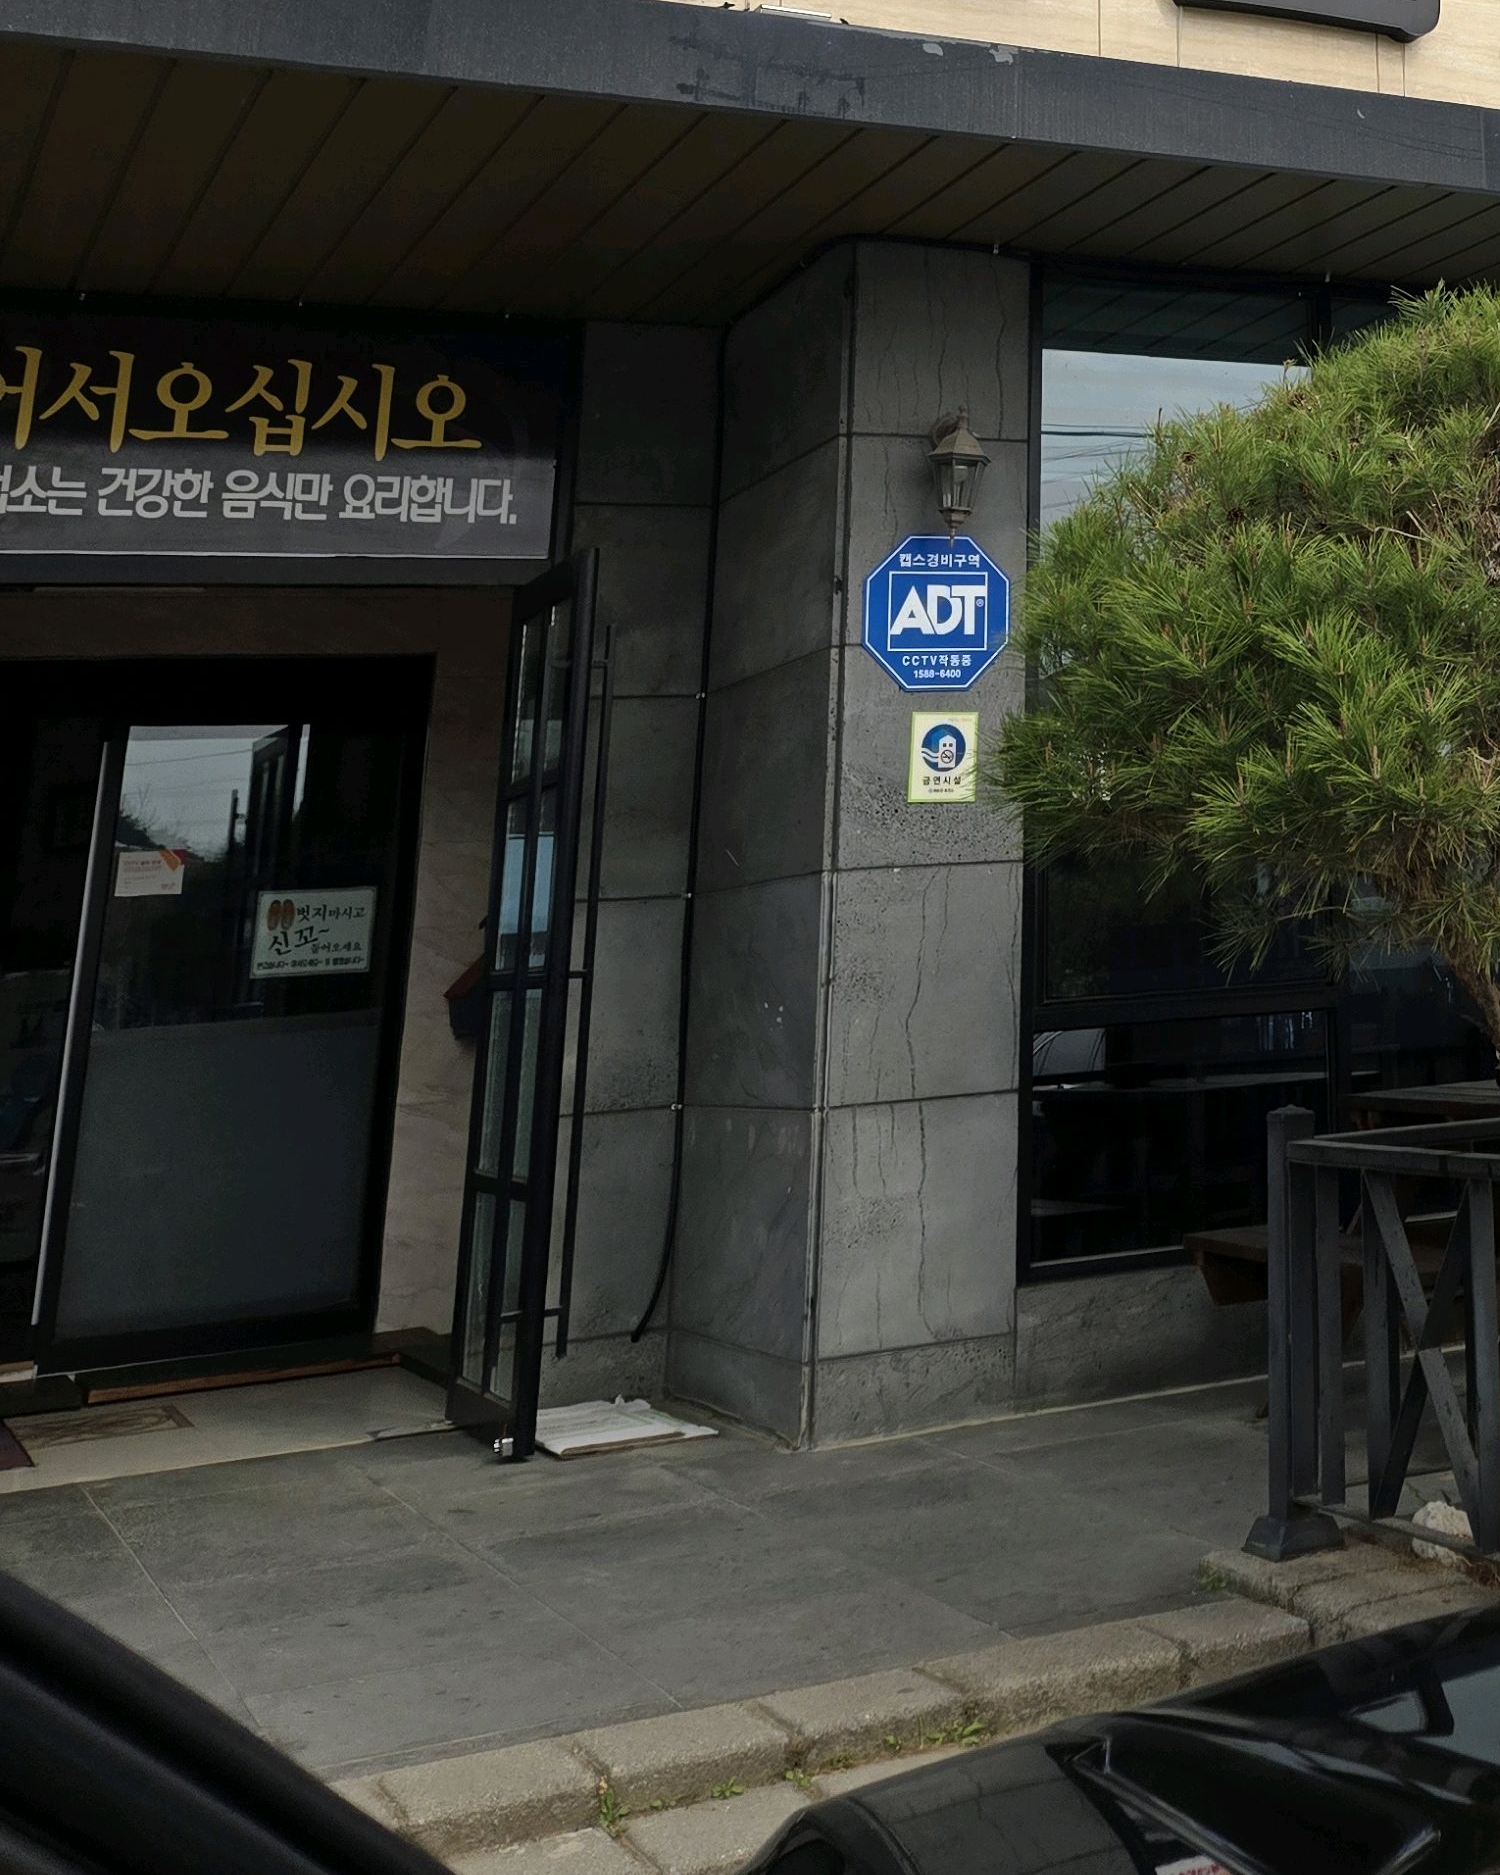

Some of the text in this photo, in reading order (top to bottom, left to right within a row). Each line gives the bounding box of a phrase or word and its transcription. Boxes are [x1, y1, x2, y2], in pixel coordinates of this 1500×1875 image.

[0, 464, 518, 525] 소는 건강한 음식만 요리합니다.
[889, 584, 986, 636] ADT
